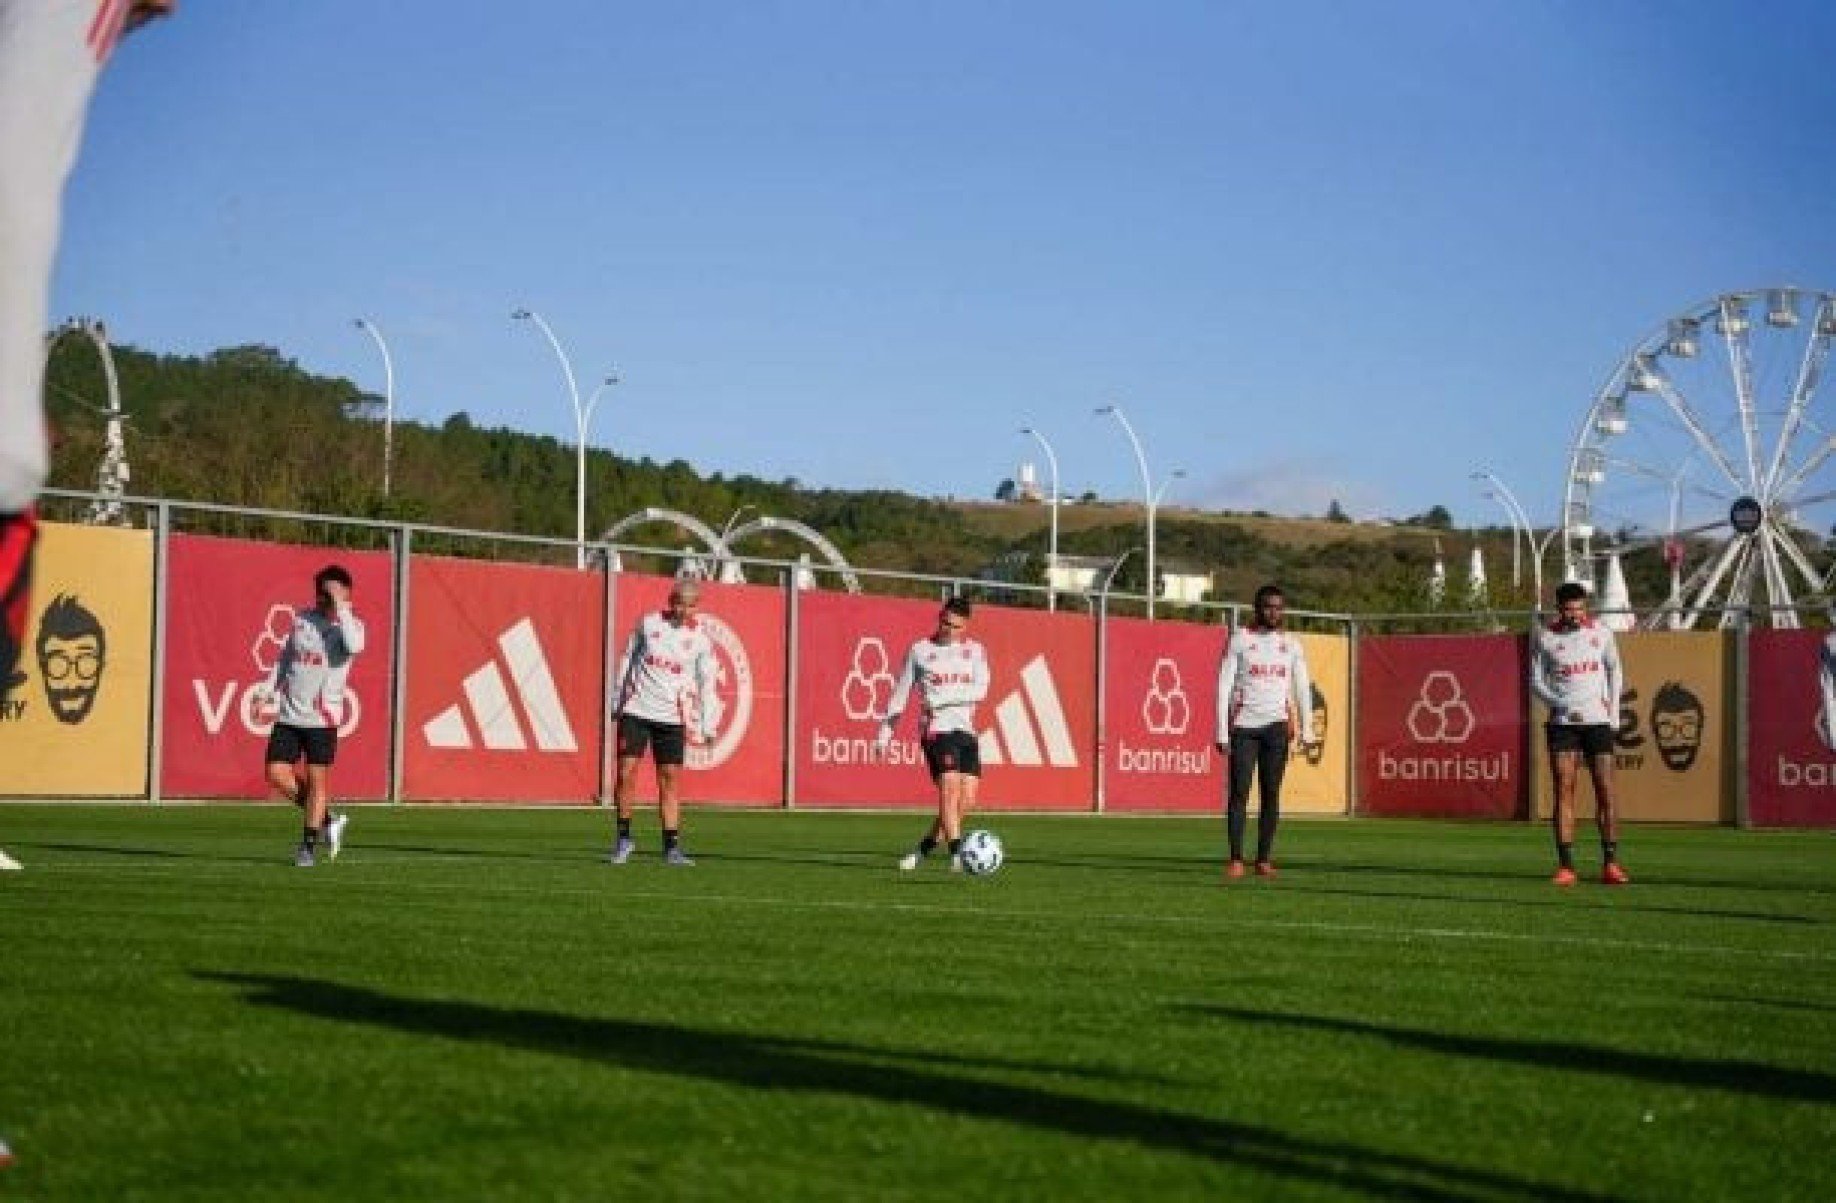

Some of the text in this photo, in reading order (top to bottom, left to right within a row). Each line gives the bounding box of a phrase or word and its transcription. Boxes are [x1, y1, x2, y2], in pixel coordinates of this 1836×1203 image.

[1119, 740, 1211, 774] banrisul
[1378, 751, 1509, 780] banrisul
[1778, 754, 1836, 786] ba
